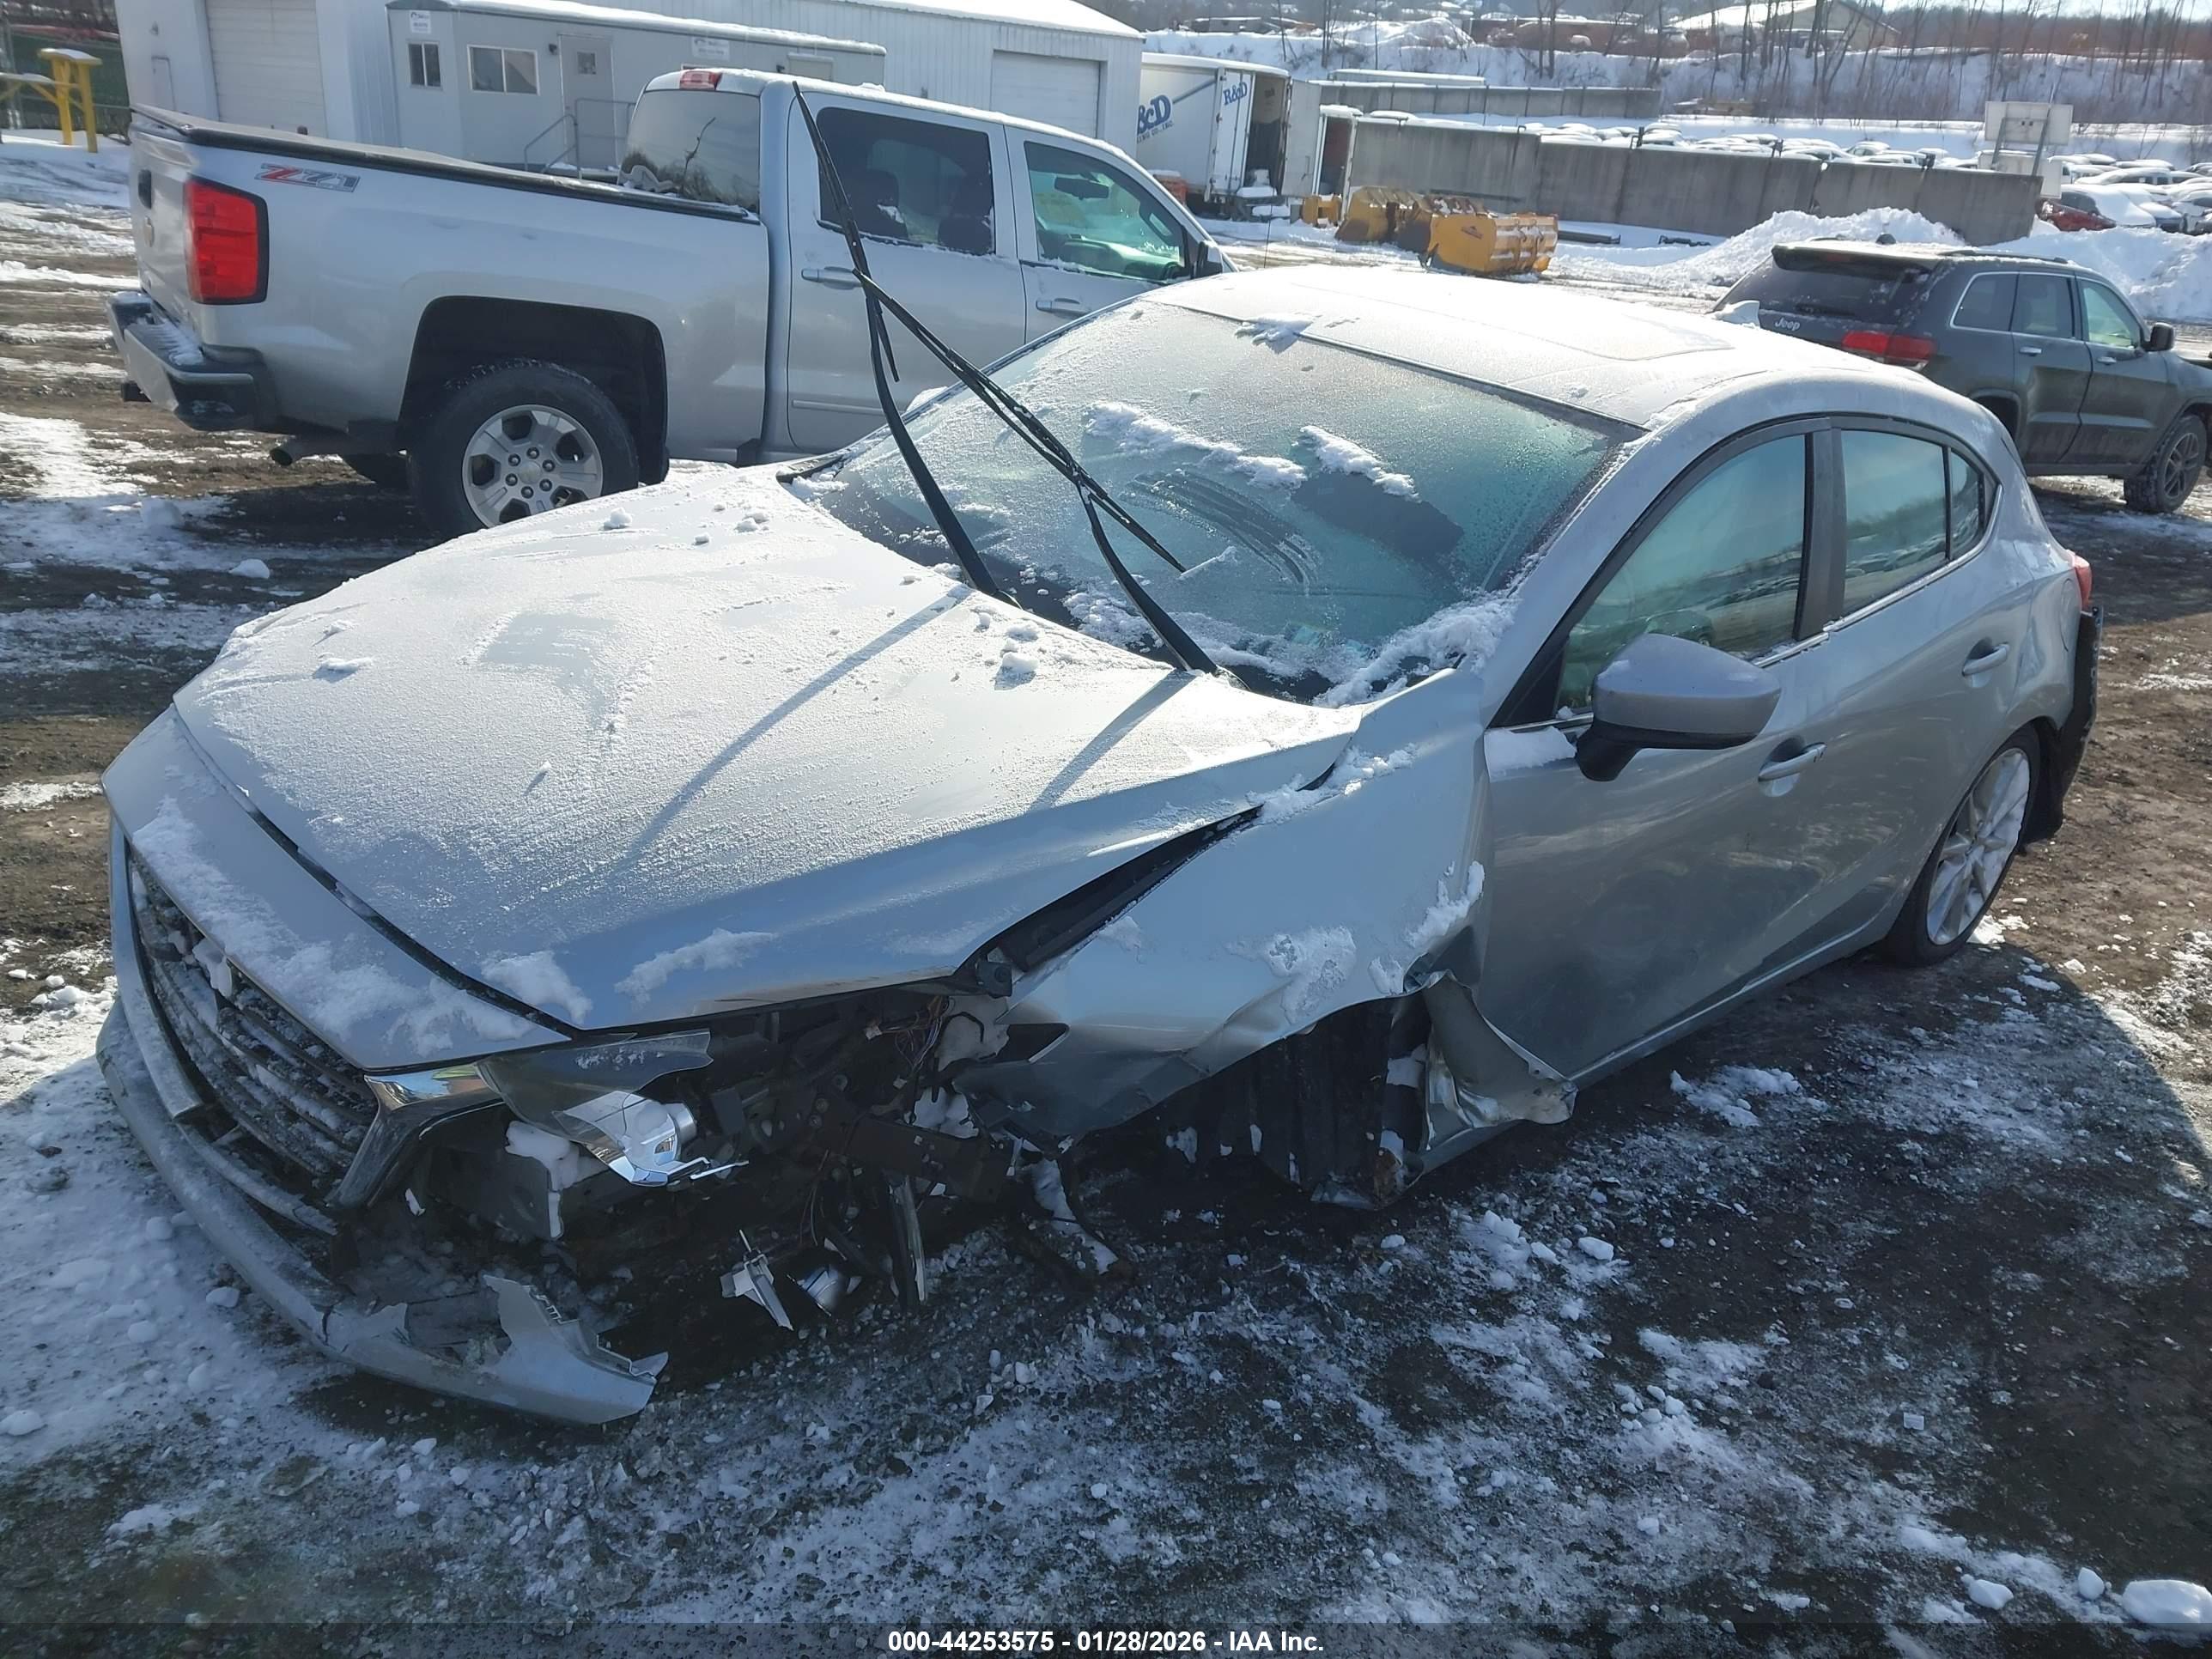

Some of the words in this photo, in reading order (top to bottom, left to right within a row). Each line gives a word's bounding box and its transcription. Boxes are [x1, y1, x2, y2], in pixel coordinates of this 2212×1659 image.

[1223, 82, 1248, 106] R&D
[254, 162, 361, 193] Z71
[1774, 317, 1801, 331] Jeep
